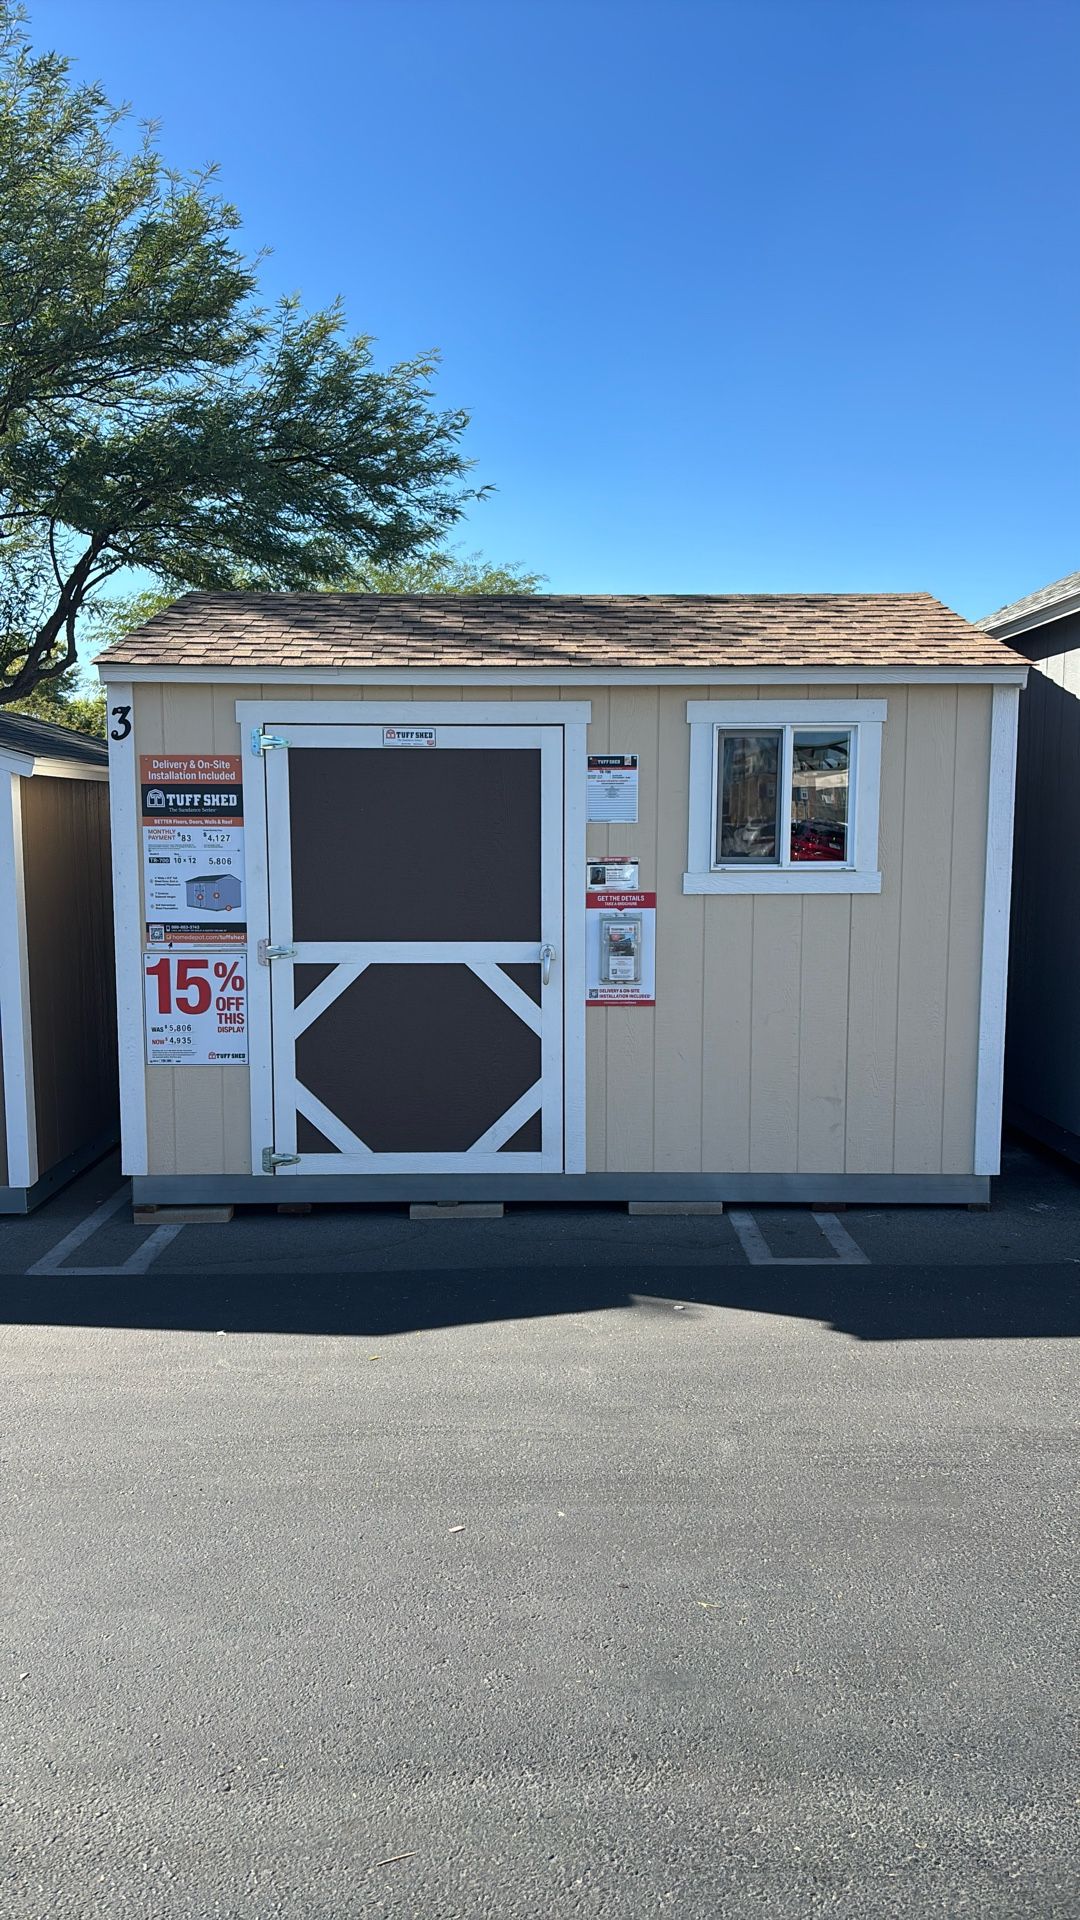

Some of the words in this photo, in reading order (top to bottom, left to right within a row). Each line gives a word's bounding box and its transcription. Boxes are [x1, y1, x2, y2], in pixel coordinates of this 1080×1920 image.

[111, 705, 132, 741] 3
[152, 760, 188, 771] Delivery
[189, 760, 196, 769] &
[197, 759, 231, 769] On-Site
[148, 771, 197, 780] Installation
[198, 771, 236, 780] Included
[166, 794, 201, 806] TUFF
[203, 794, 238, 806] SHED
[203, 832, 231, 843] $4,127
[208, 857, 232, 865] 5,806
[172, 933, 245, 941] homedepot.com/tuffshed
[216, 997, 244, 1011] OFF
[217, 1013, 245, 1025] THIS
